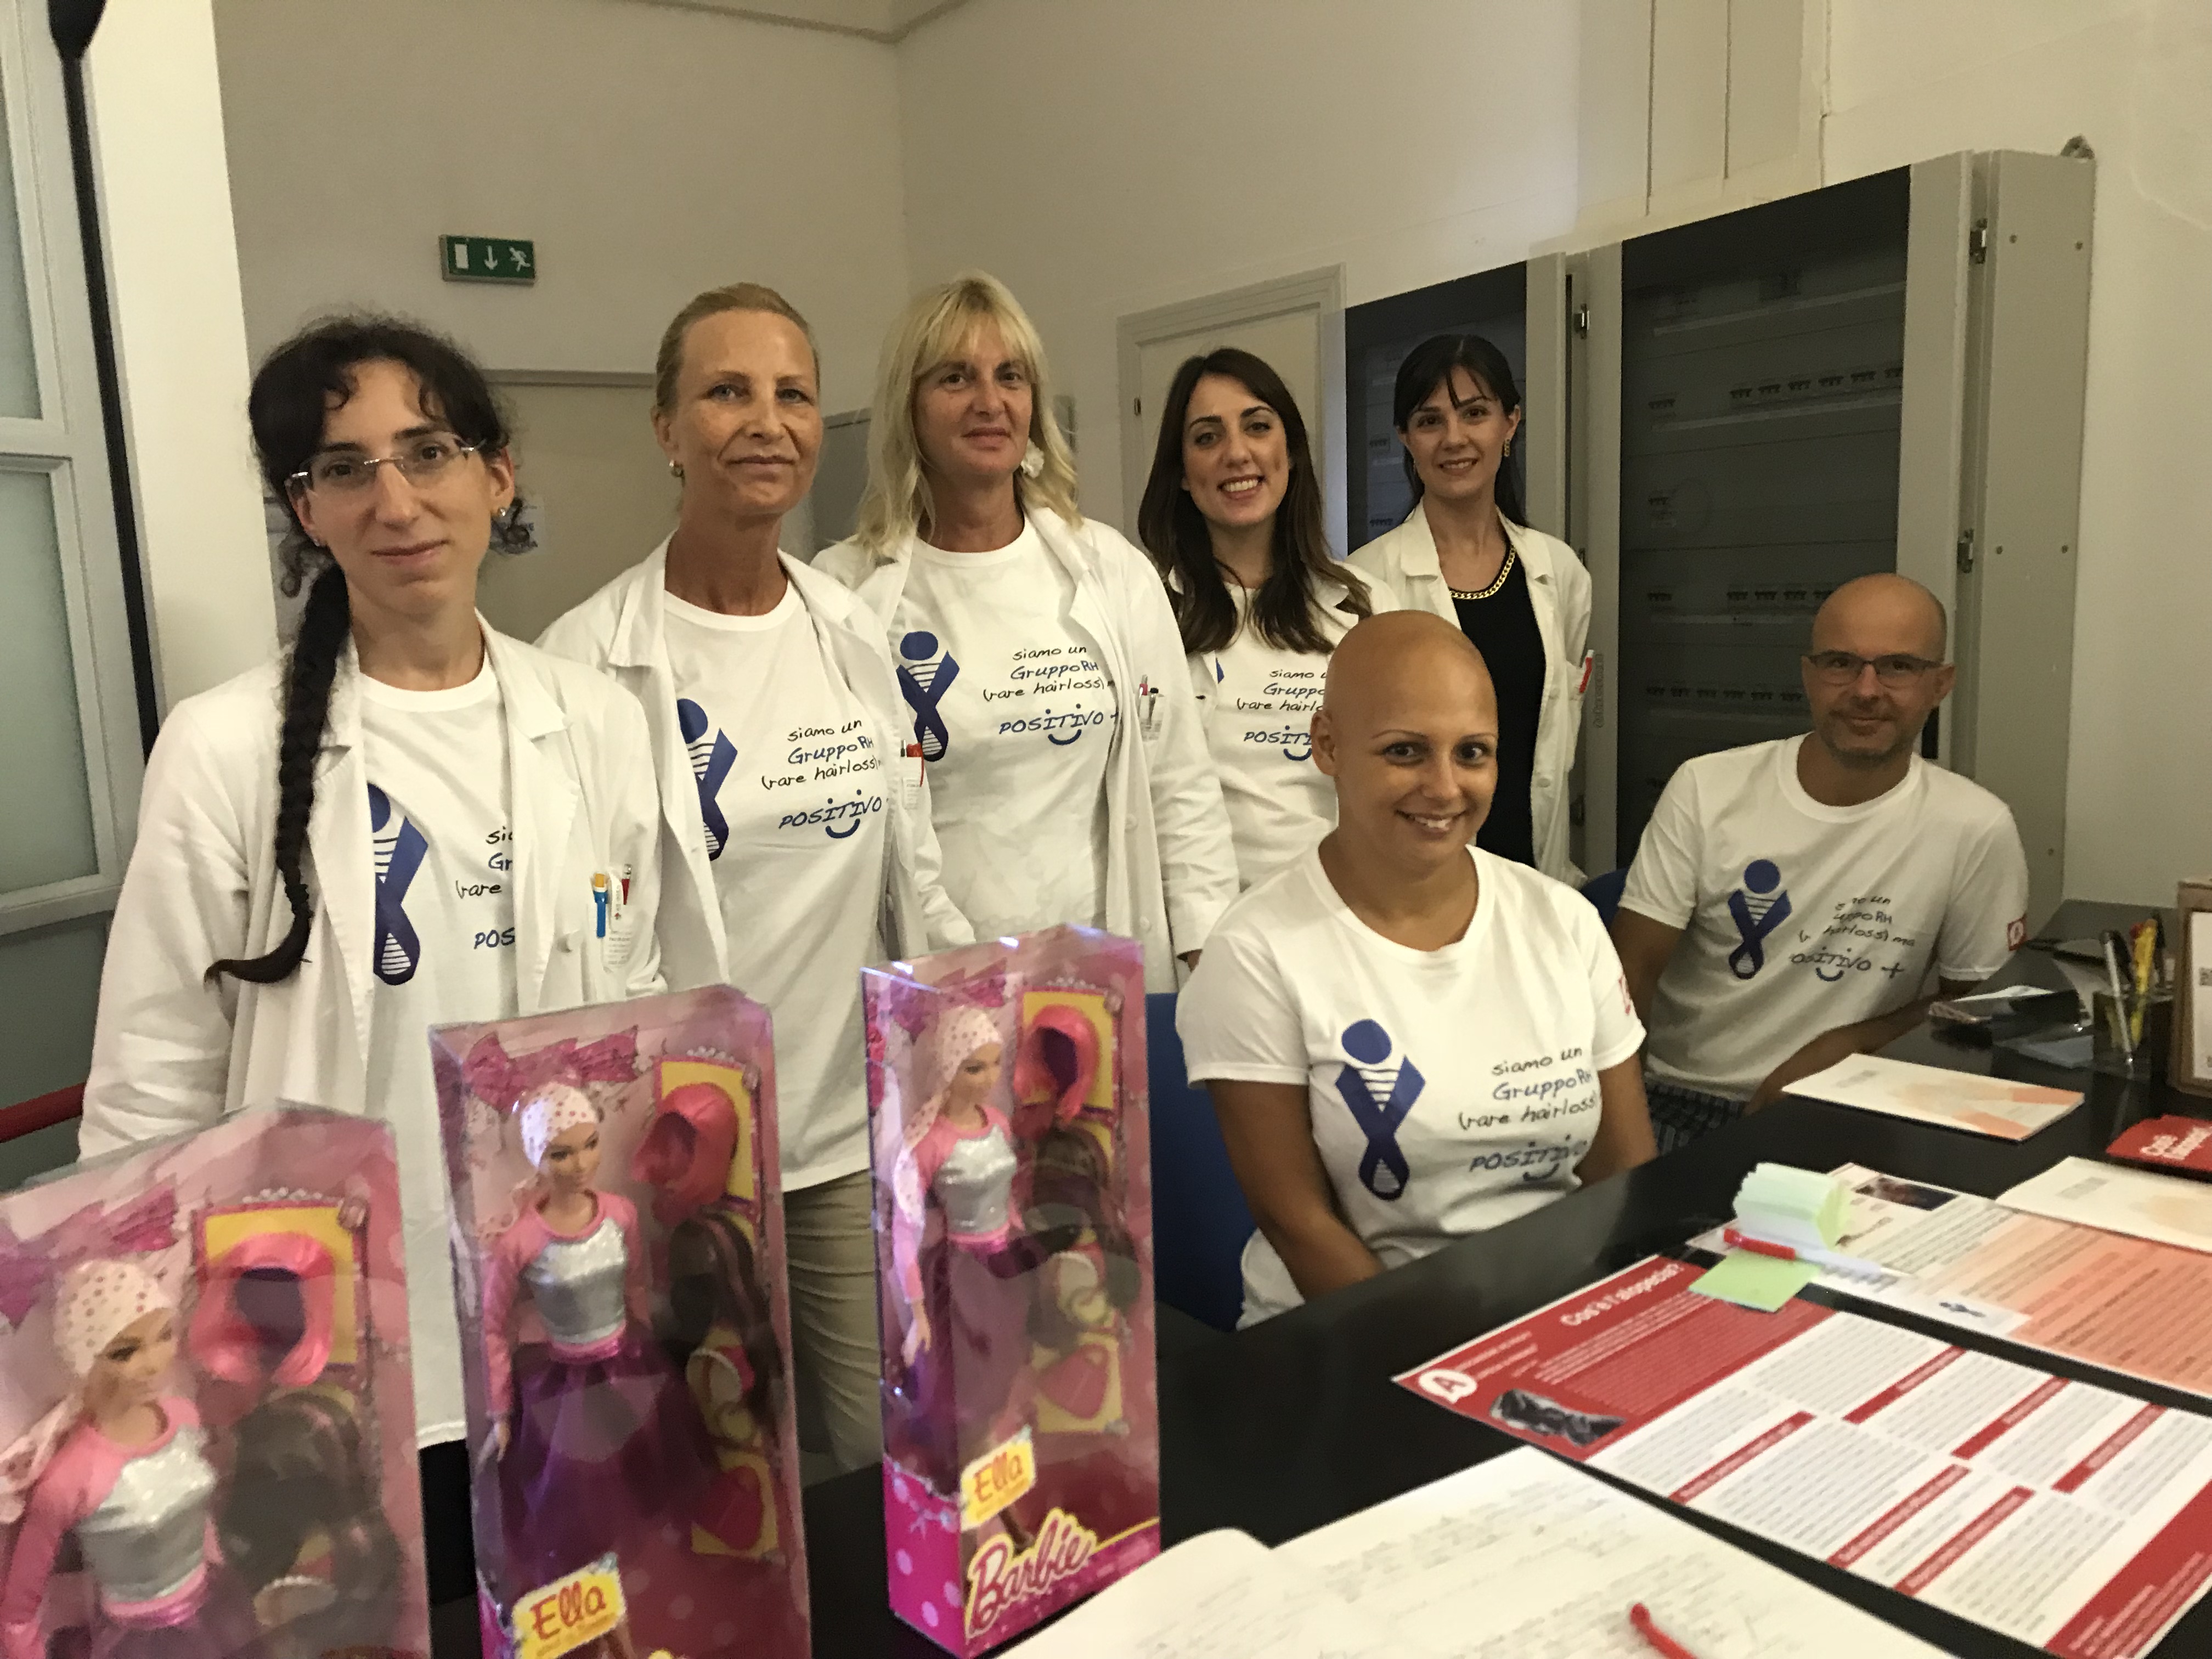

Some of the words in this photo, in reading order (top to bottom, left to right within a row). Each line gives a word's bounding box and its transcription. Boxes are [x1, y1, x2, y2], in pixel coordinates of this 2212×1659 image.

[1013, 648, 1062, 661] siamo
[1269, 669, 1314, 679] siamo
[983, 689, 1025, 702] (rare
[1033, 676, 1104, 695] hairloss)
[1237, 698, 1273, 710] (rare
[787, 727, 834, 742] siamo
[841, 719, 862, 733] un
[761, 775, 806, 790] (rare
[814, 754, 878, 780] hairloss)
[455, 879, 503, 899] (rare
[473, 927, 515, 950] POS
[1491, 1059, 1553, 1076] siamo
[1561, 1047, 1583, 1061] un
[974, 1451, 1024, 1503] Ella
[967, 1516, 1093, 1632] Barbie
[529, 1579, 607, 1640] Ella
